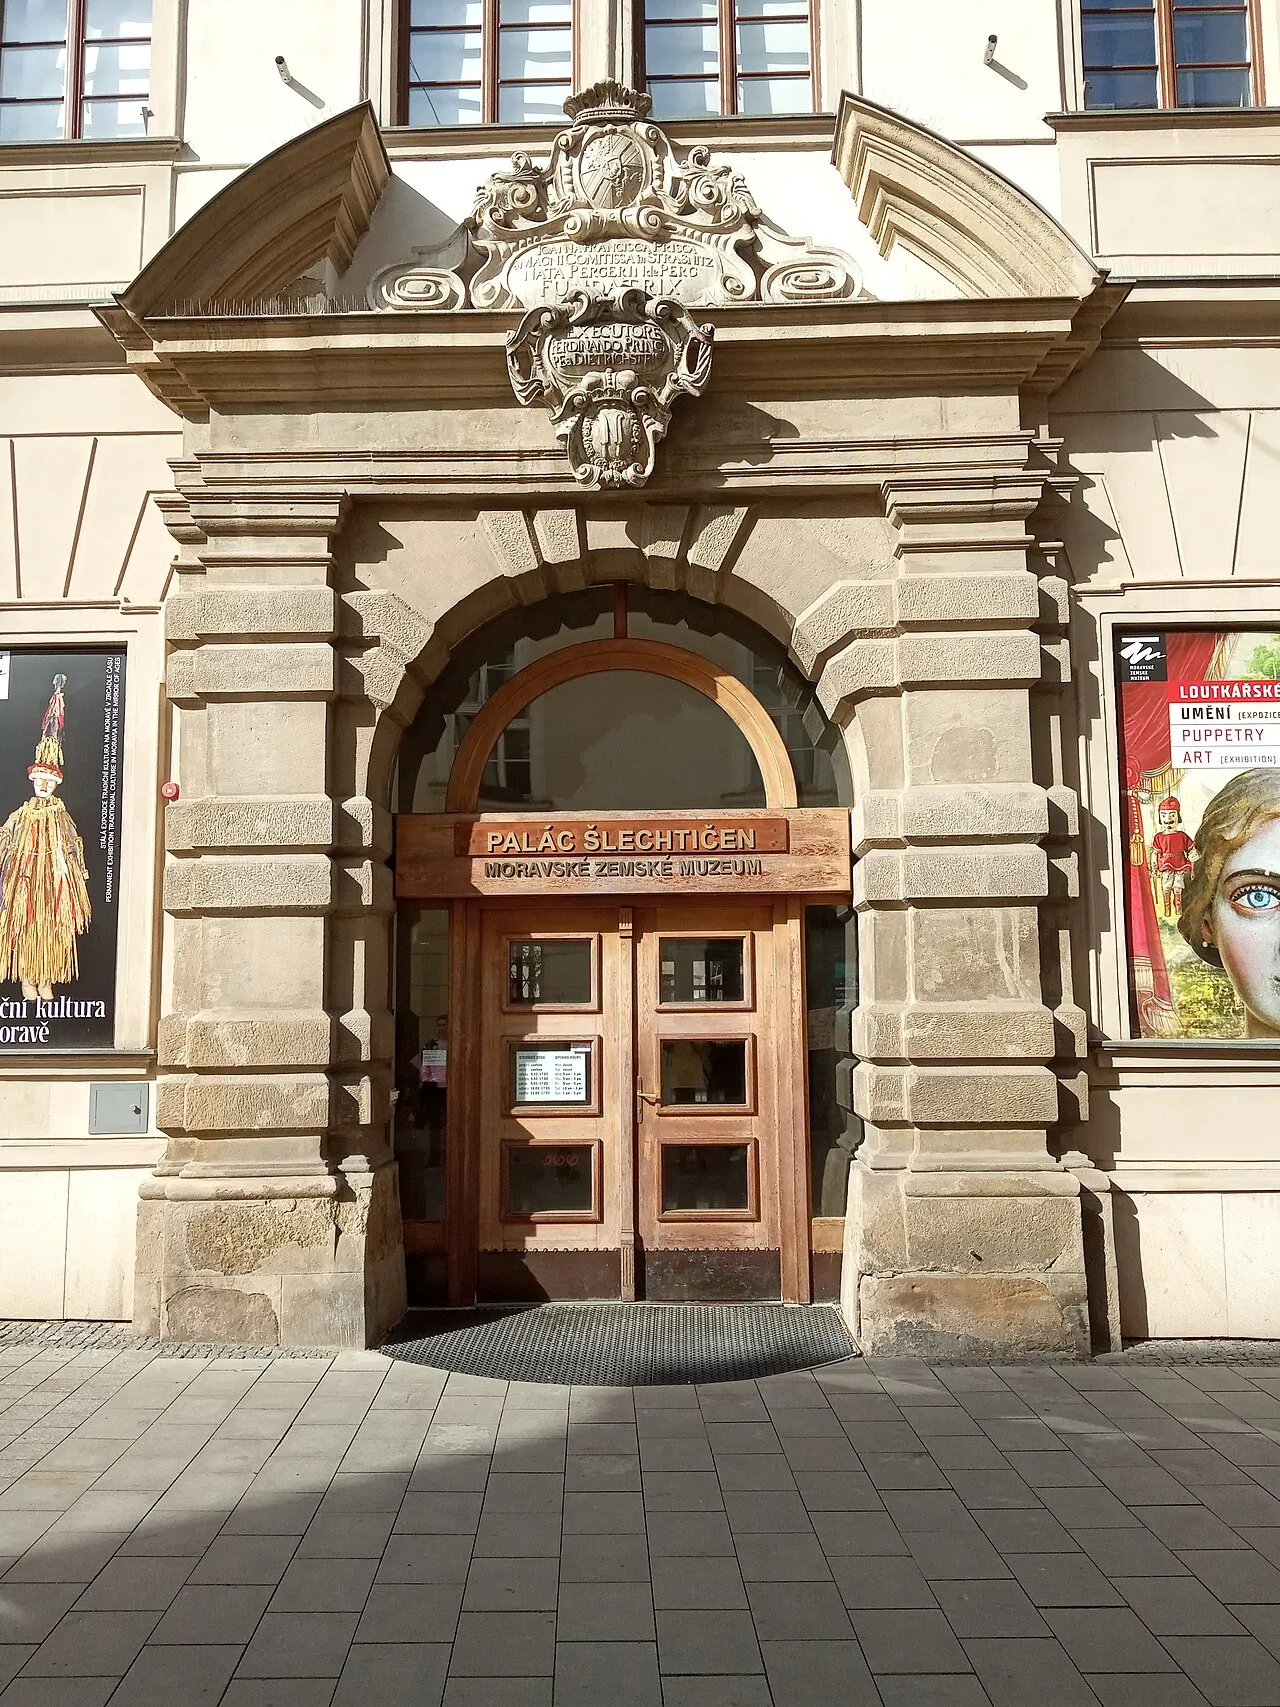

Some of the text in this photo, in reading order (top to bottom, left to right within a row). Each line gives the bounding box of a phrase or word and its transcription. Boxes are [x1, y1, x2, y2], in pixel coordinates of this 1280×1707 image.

[565, 253, 635, 266] COMITISSA
[567, 324, 663, 340] EXECUTORE
[552, 337, 622, 355] FERDINANDO
[113, 674, 120, 682] OF
[1179, 683, 1280, 699] LOUTKÁŘSKÉ
[1181, 704, 1231, 719] UMĚNÍ
[104, 734, 110, 742] NA
[1182, 728, 1264, 742] PUPPETRY
[1183, 750, 1212, 763] ART
[109, 763, 117, 791] CULTURE
[108, 792, 116, 831] TRADITIONAL
[487, 823, 757, 853] PALÁC ŠLECHTIČEN
[106, 832, 114, 866] EXHIBITION
[484, 854, 763, 878] MORAVSKÉ ZEMSKÉ MUZEUM
[105, 867, 113, 903] PERMANENT
[35, 995, 106, 1018] kultura
[0, 1020, 50, 1043] oravě
